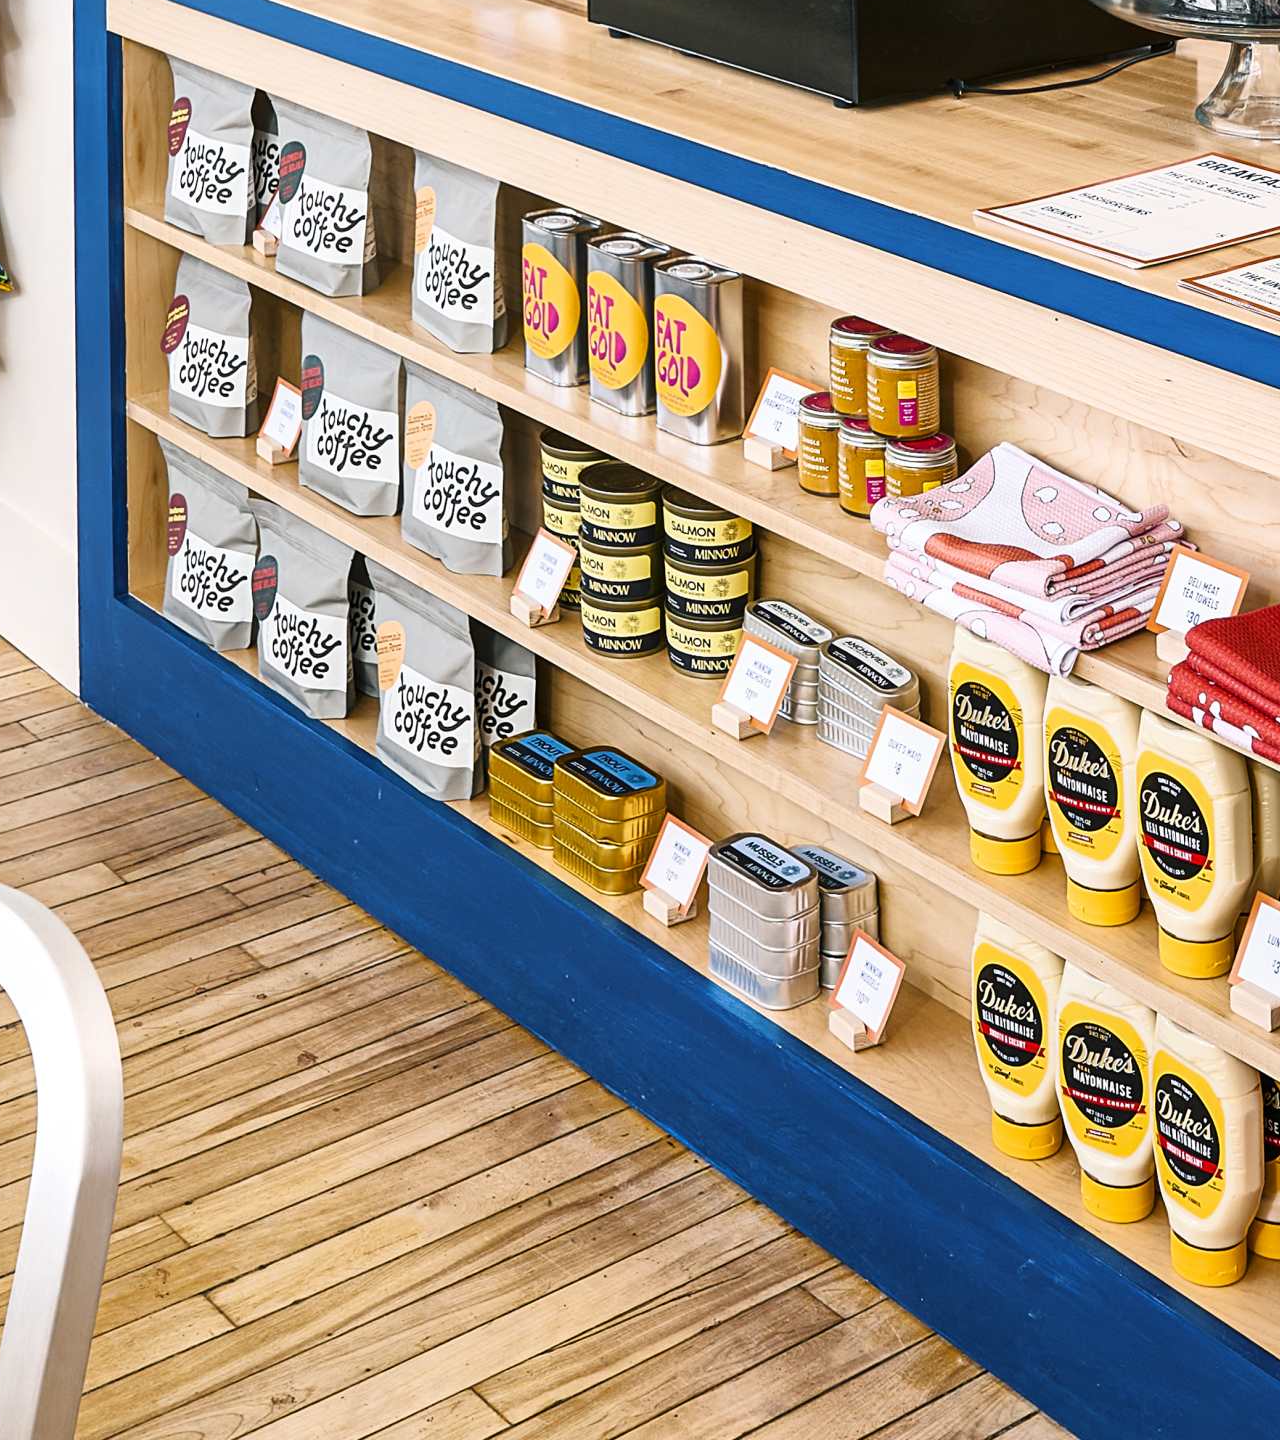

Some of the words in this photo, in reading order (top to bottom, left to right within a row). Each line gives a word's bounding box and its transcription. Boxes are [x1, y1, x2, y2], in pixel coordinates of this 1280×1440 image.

[183, 136, 245, 184] touchy
[179, 164, 233, 204] coffee
[299, 182, 366, 232] touchy
[293, 212, 353, 255] coffee
[428, 233, 490, 289] touchy
[523, 260, 548, 301] FAT
[1240, 271, 1261, 282] THE
[424, 265, 479, 311] coffee
[587, 287, 615, 329] FAT
[525, 299, 560, 341] GOLD
[656, 310, 687, 355] FAT
[183, 330, 247, 378] touchy
[589, 325, 627, 369] GOLD
[178, 360, 235, 398] coffee
[657, 355, 702, 398] GOLD
[320, 399, 393, 449] touchy
[316, 432, 382, 472] coffee
[428, 453, 500, 509] touchy
[424, 488, 488, 531] coffee
[671, 520, 715, 538] SALMON
[593, 529, 636, 543] MINNOW
[695, 546, 739, 560] MINNOW
[184, 538, 248, 591] touchy
[180, 570, 234, 613] coffee
[589, 581, 629, 596] MINNOW
[686, 601, 731, 614] MINNOW
[1183, 587, 1194, 599] TEA
[1195, 592, 1220, 610] TOWELS
[1203, 582, 1220, 596] MEAT
[274, 601, 342, 658] touchy
[771, 603, 809, 627] ANCHOVIES
[1186, 610, 1200, 626] $30
[272, 634, 330, 680] coffee
[598, 637, 642, 651] MINNOW
[670, 629, 712, 649] SALMON
[845, 639, 889, 667] ANCHOVIES
[398, 673, 471, 732] touchy
[956, 694, 1012, 732] Duke's
[394, 709, 459, 756] coffee
[531, 737, 565, 756] TROUT
[960, 725, 1009, 755] MAYONNAISE
[597, 753, 631, 772] TROUT
[1051, 740, 1110, 779] Duke's
[1057, 772, 1108, 803] MAYONNAISE
[1142, 790, 1202, 833] Duke's
[745, 841, 786, 866] MUSSELS
[802, 850, 842, 871] MUSSELS
[979, 980, 1035, 1022] Duke's
[1066, 1035, 1135, 1073] Duke's
[1073, 1067, 1132, 1099] MAYONNAISE
[1157, 1090, 1213, 1140] Duke's
